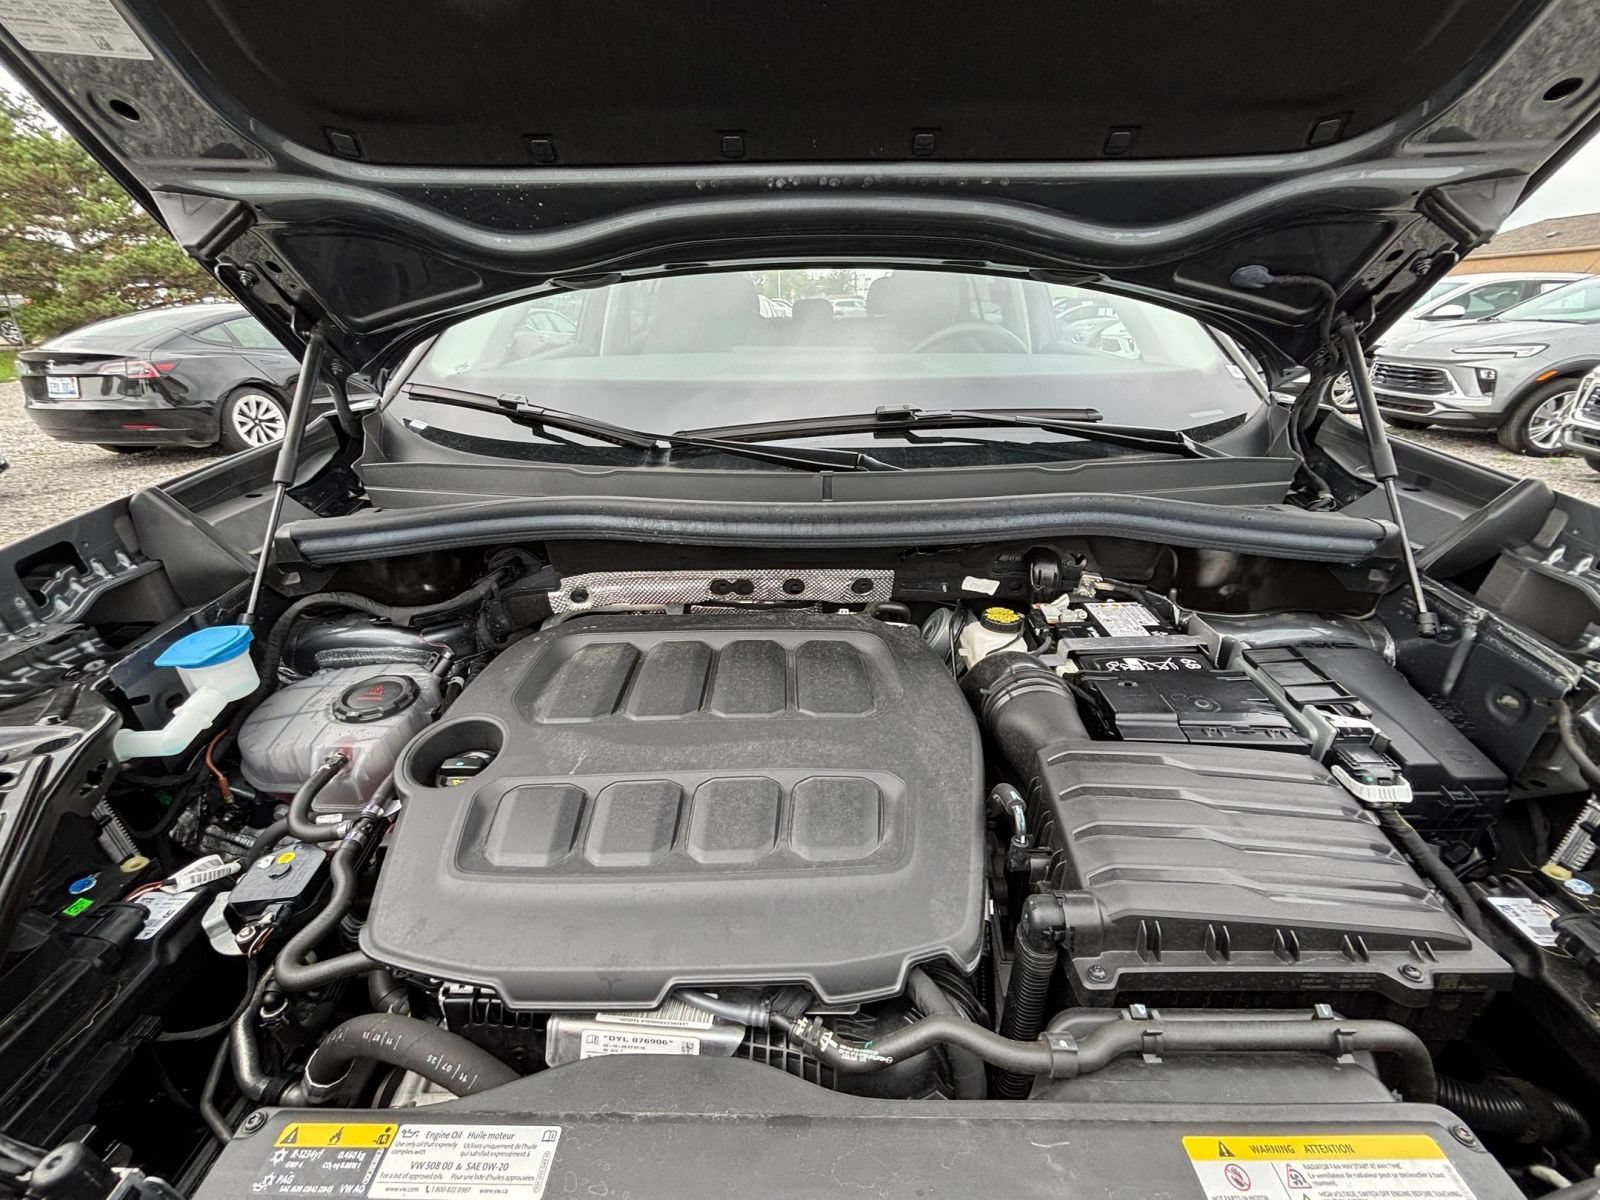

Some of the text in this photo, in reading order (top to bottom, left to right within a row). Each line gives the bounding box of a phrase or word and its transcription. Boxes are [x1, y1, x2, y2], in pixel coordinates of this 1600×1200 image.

[426, 1130, 463, 1141] Engine Oil
[467, 1131, 515, 1140] Huile moteur
[1249, 1144, 1356, 1154] WARNING ATTENTION
[410, 1161, 510, 1171] VW 508 00 & SAE 0W-20
[276, 1174, 296, 1184] PAG
